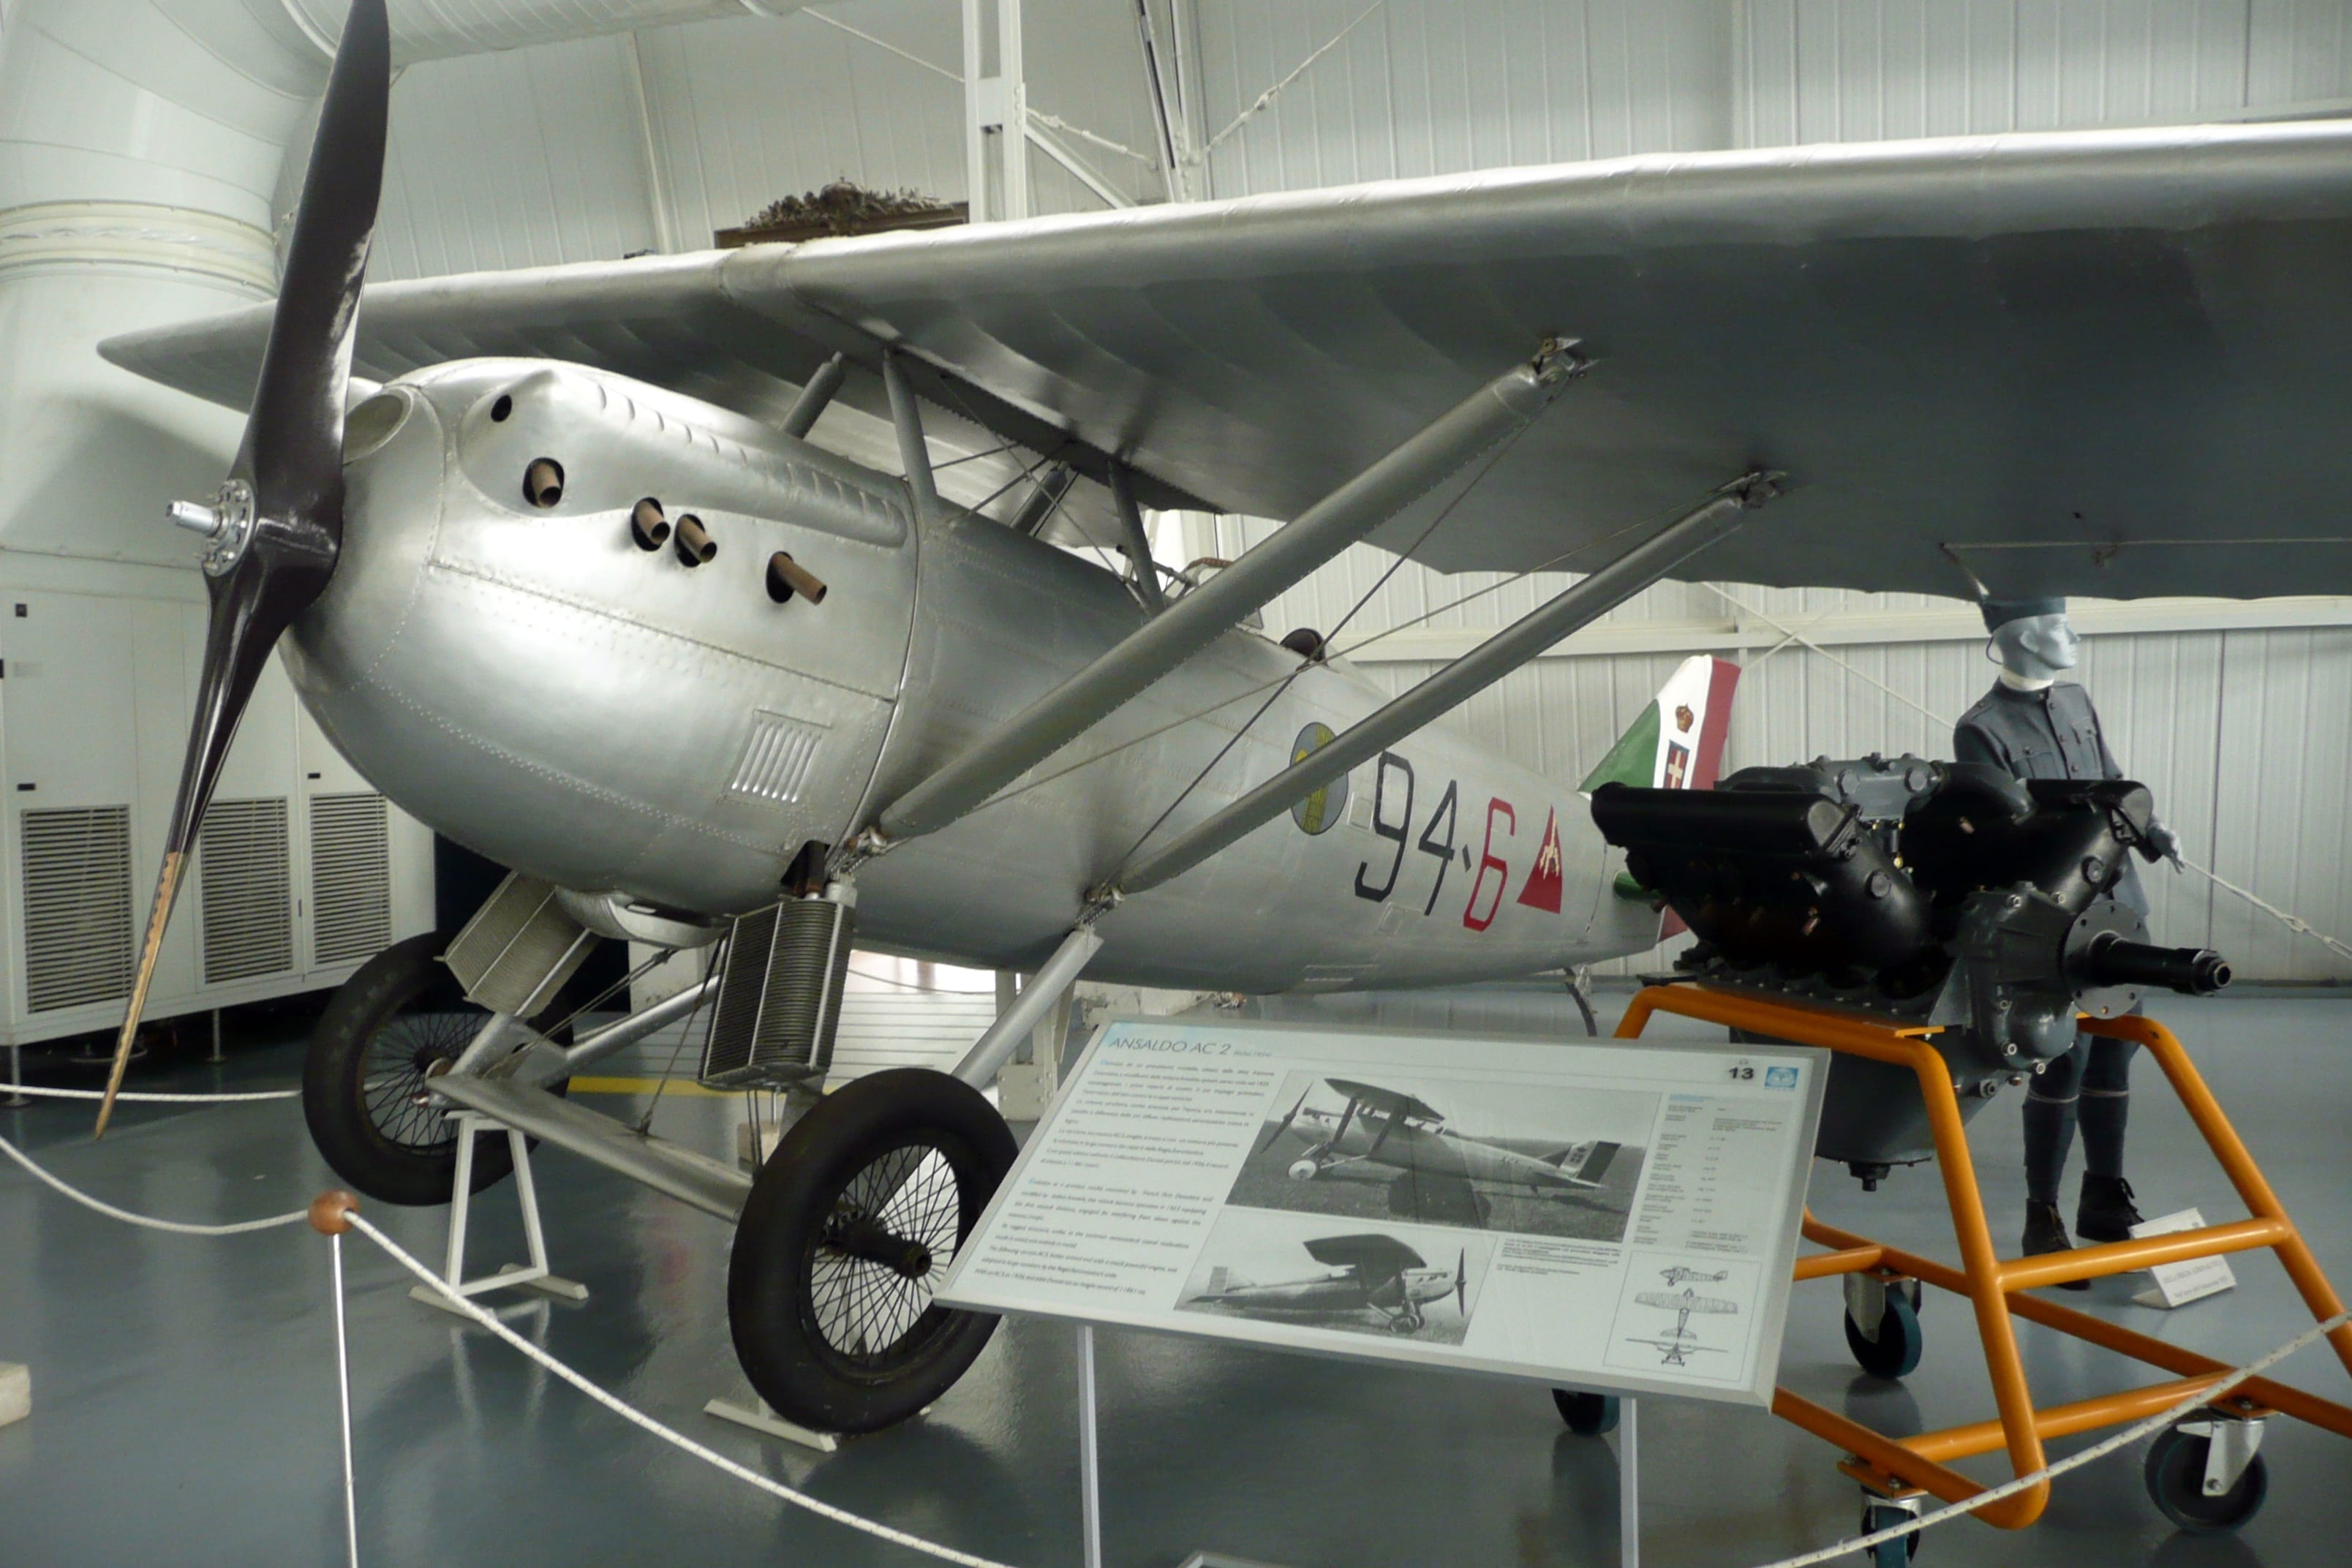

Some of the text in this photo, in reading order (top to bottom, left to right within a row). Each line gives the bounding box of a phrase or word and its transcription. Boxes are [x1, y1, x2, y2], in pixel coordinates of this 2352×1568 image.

[1108, 1037, 1187, 1053] ANSALDO
[1189, 1041, 1216, 1055] AC
[1218, 1044, 1232, 1055] 2
[1728, 1066, 1754, 1080] 13
